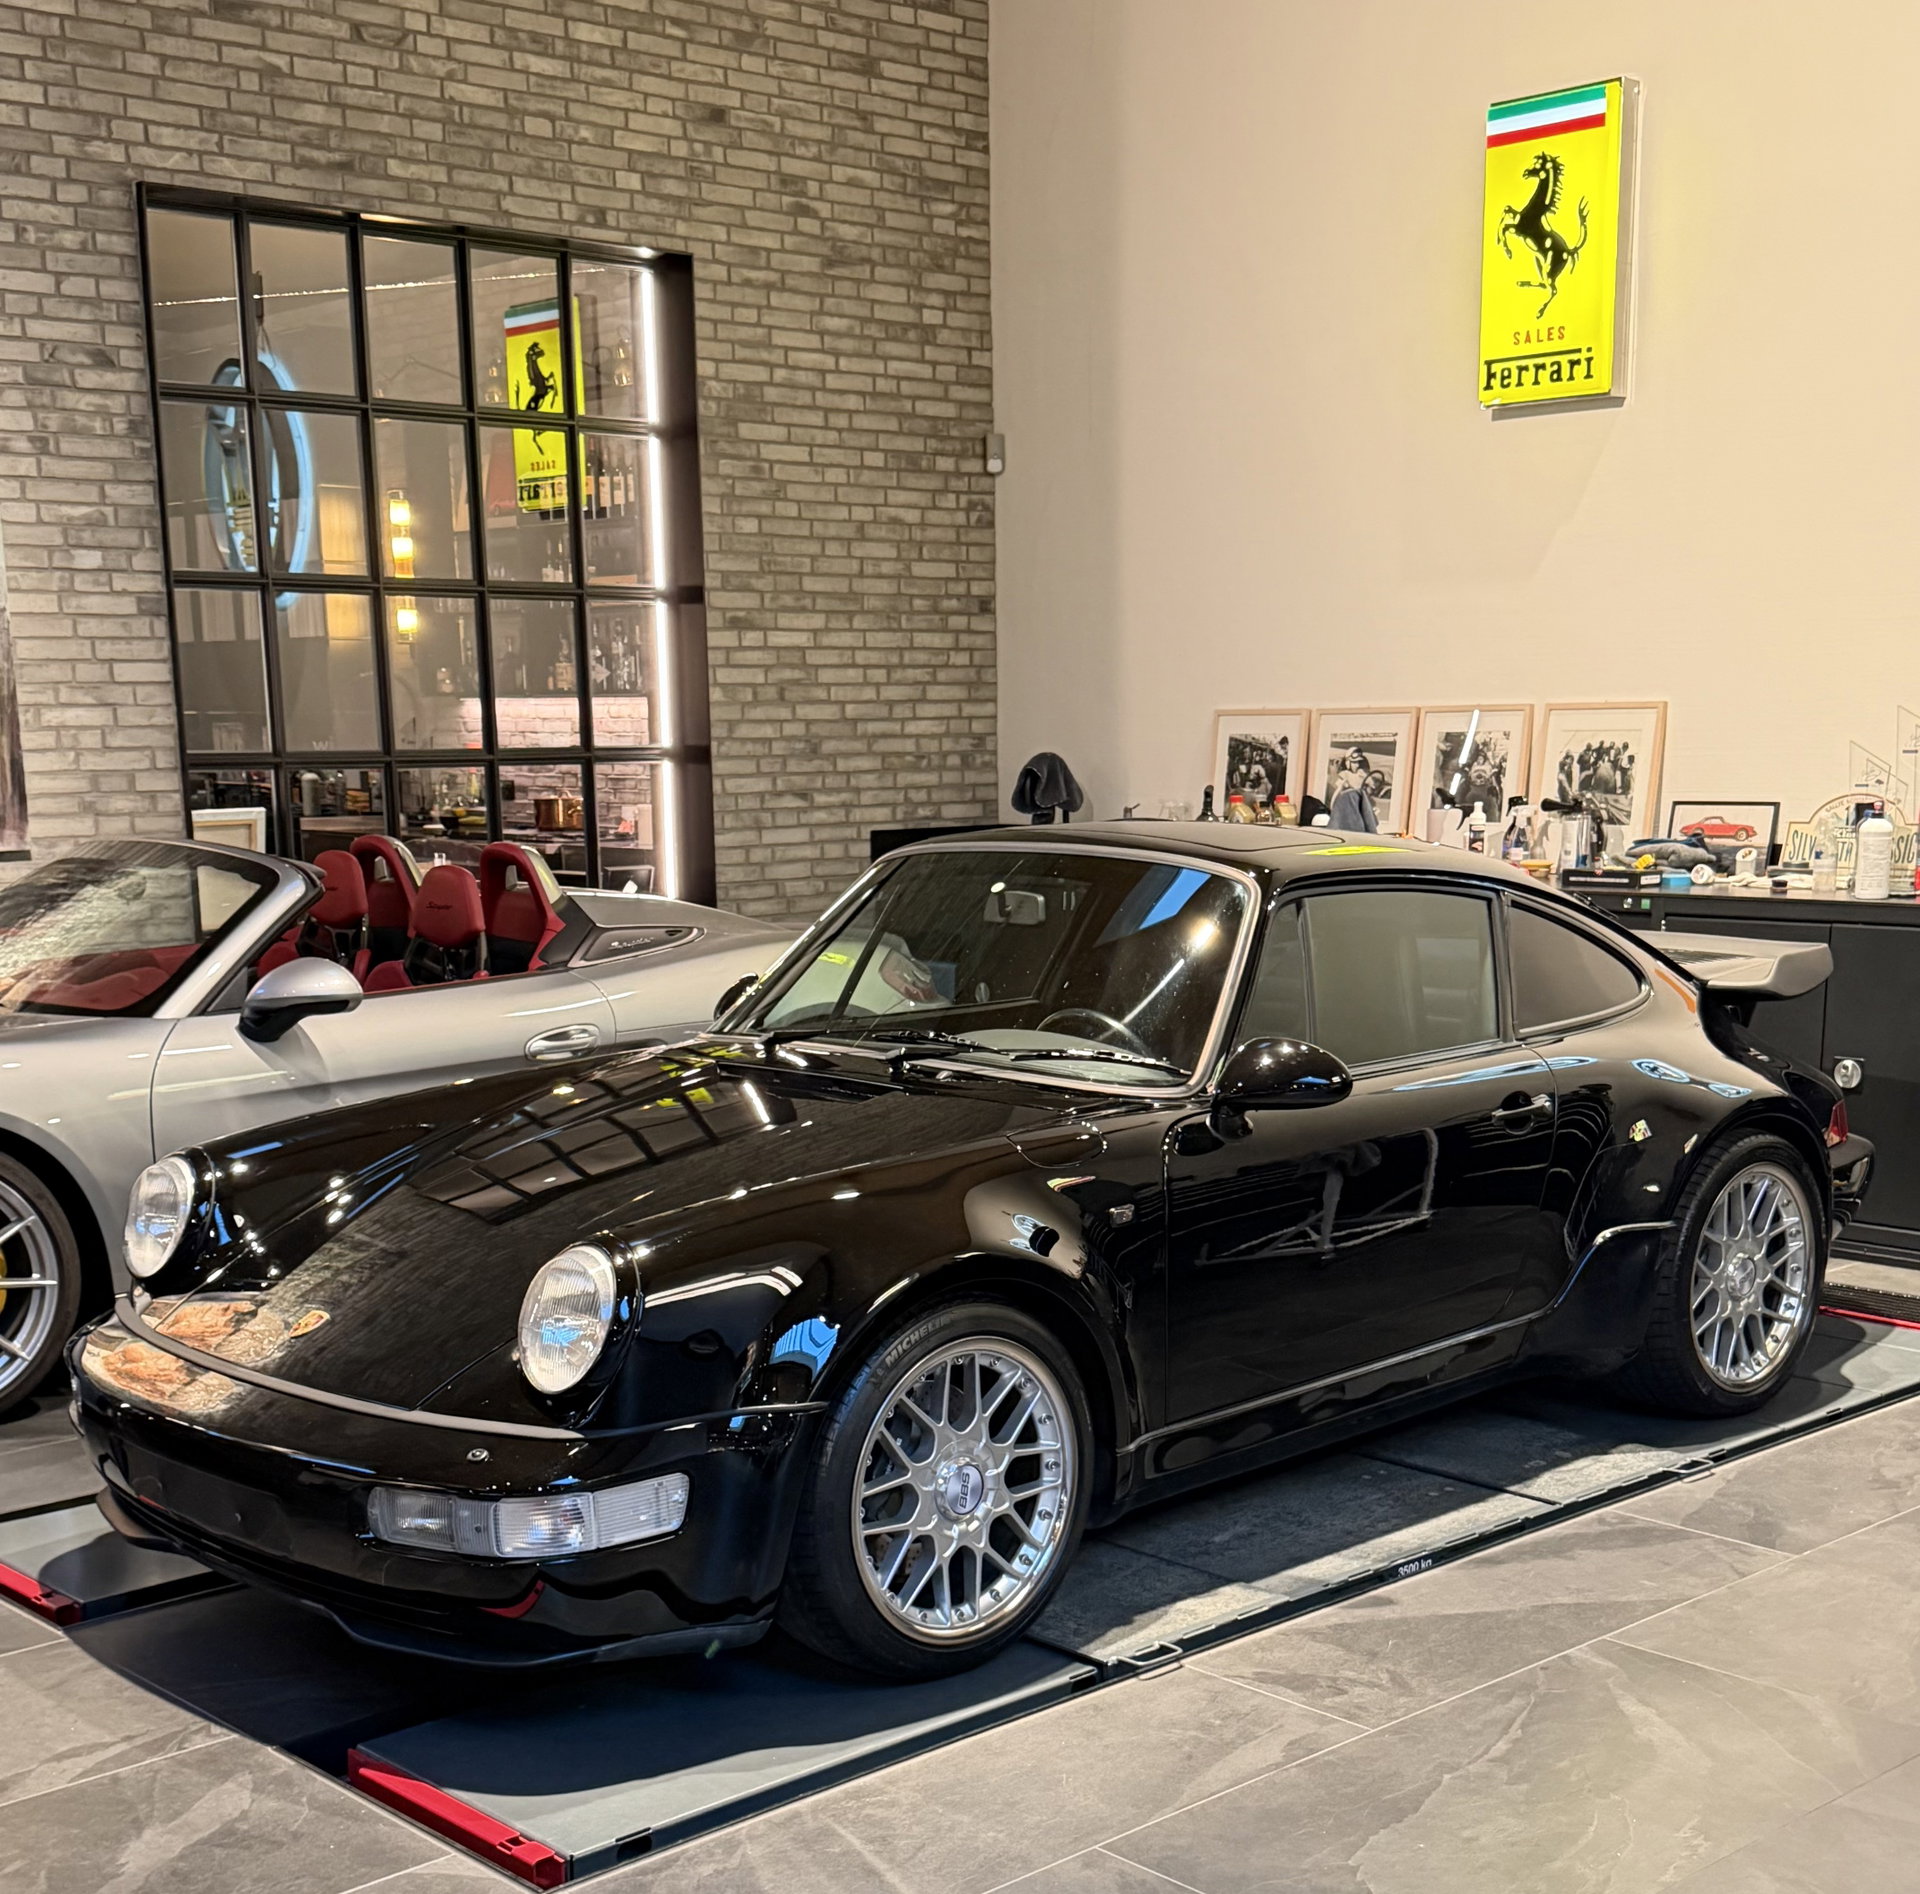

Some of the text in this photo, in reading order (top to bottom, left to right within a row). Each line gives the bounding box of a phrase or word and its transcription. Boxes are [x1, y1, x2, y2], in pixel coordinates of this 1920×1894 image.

[1513, 326, 1565, 345] SALES
[1483, 347, 1594, 391] Ferrari
[959, 1472, 970, 1509] BBS
